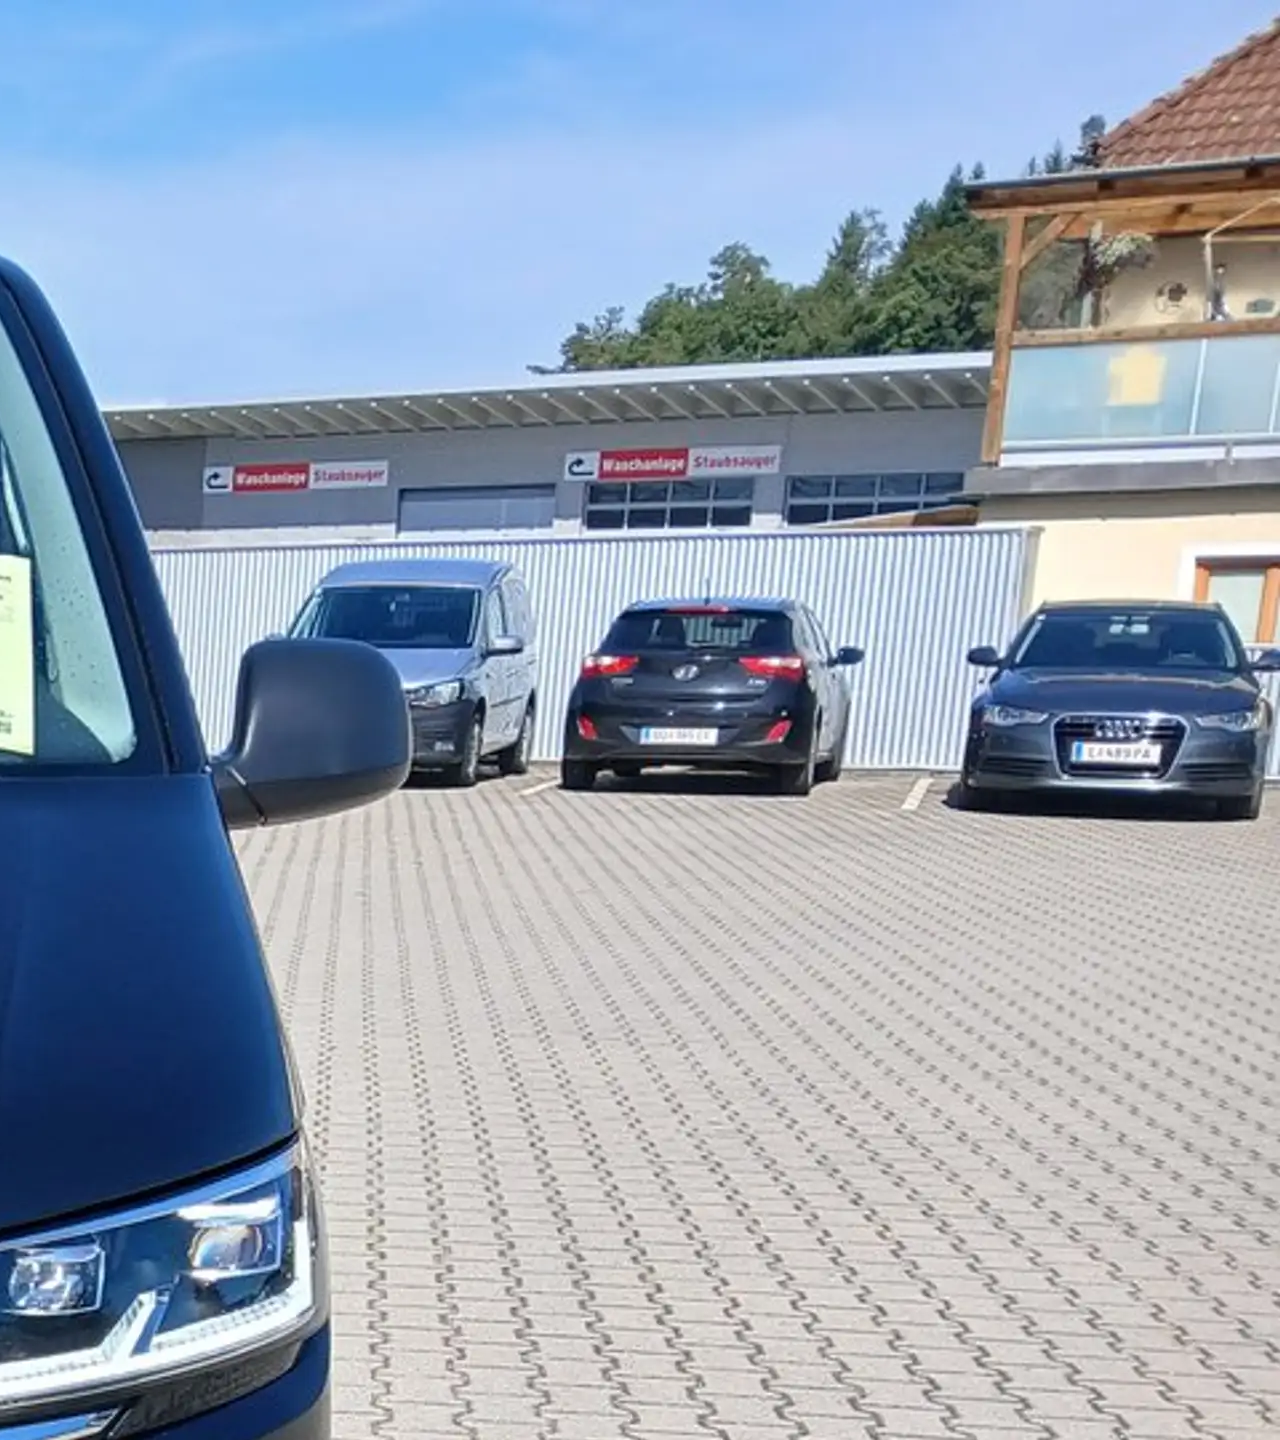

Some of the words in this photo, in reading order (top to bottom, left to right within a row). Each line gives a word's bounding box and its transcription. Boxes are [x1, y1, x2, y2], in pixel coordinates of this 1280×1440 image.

[601, 457, 685, 473] Waschanlage
[693, 454, 777, 470] Staubsauger
[235, 471, 307, 487] Waschanlage
[313, 468, 386, 484] Staubsauger
